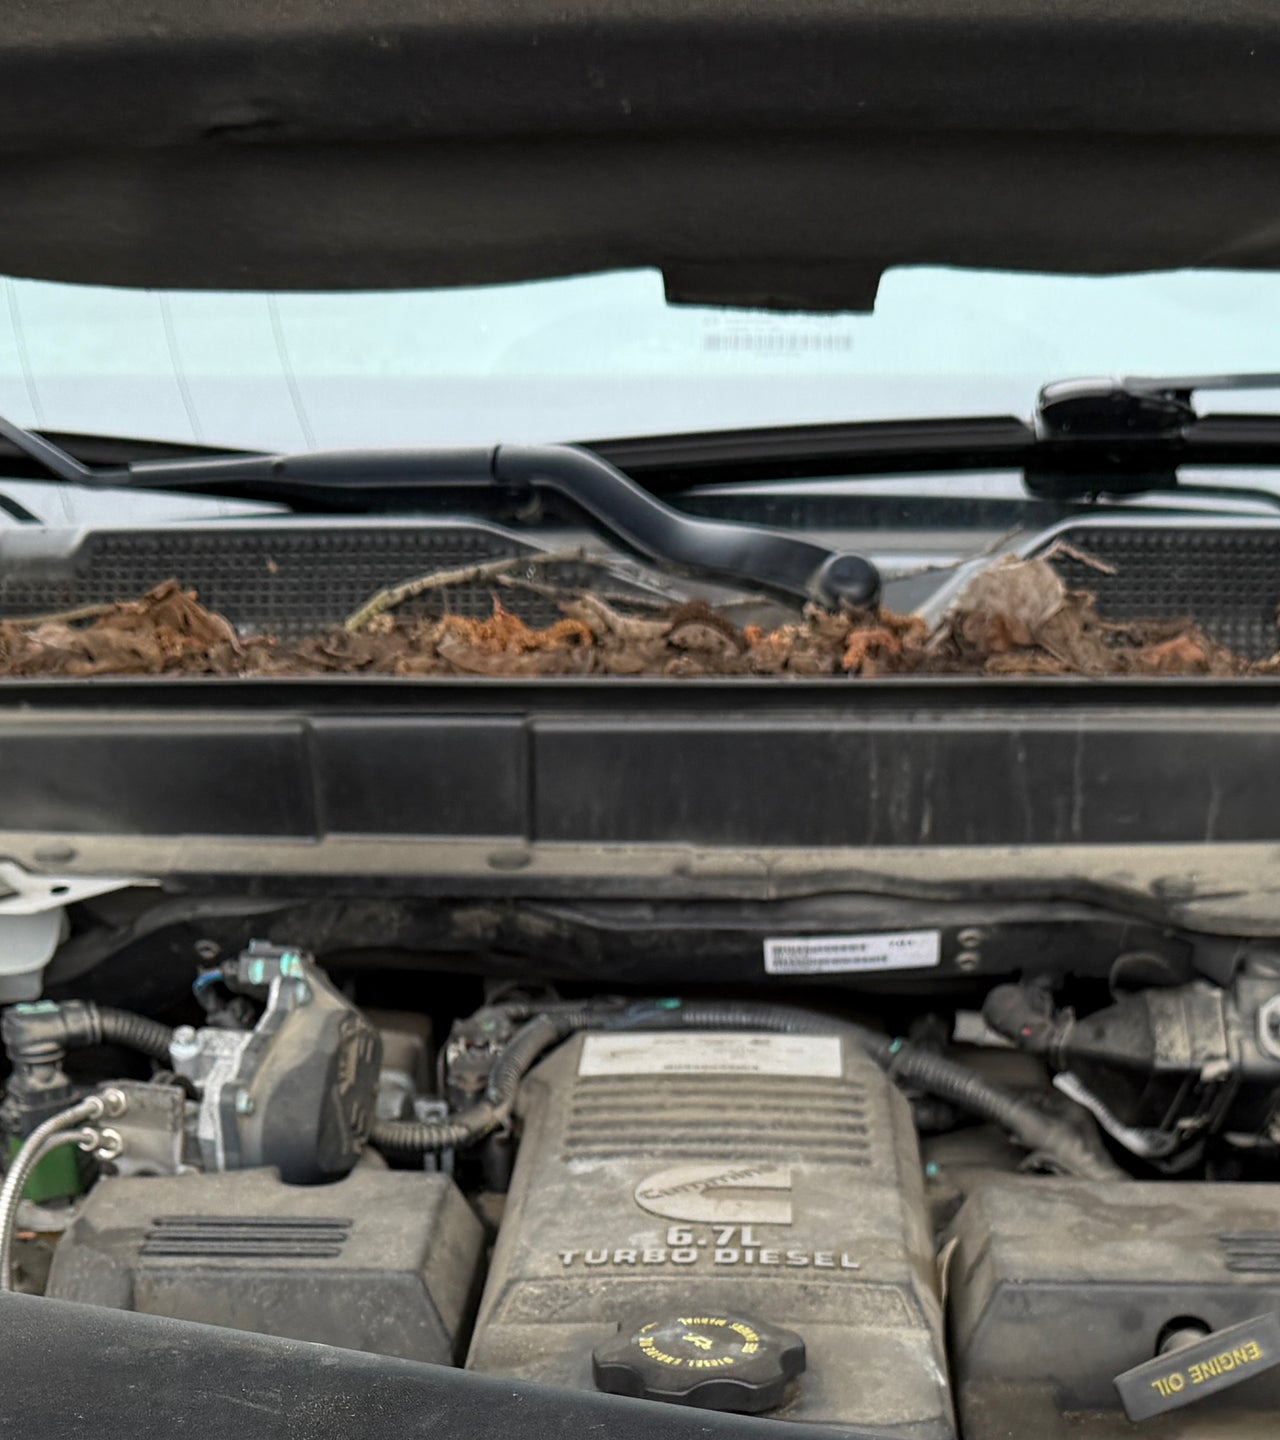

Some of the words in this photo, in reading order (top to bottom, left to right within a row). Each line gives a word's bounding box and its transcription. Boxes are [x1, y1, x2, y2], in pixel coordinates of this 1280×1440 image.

[667, 1225, 761, 1247] 6.7L
[558, 1248, 699, 1266] TURBO
[713, 1248, 860, 1269] DIESEL
[1188, 1341, 1263, 1384] ENGINE
[1151, 1373, 1185, 1397] OIL
